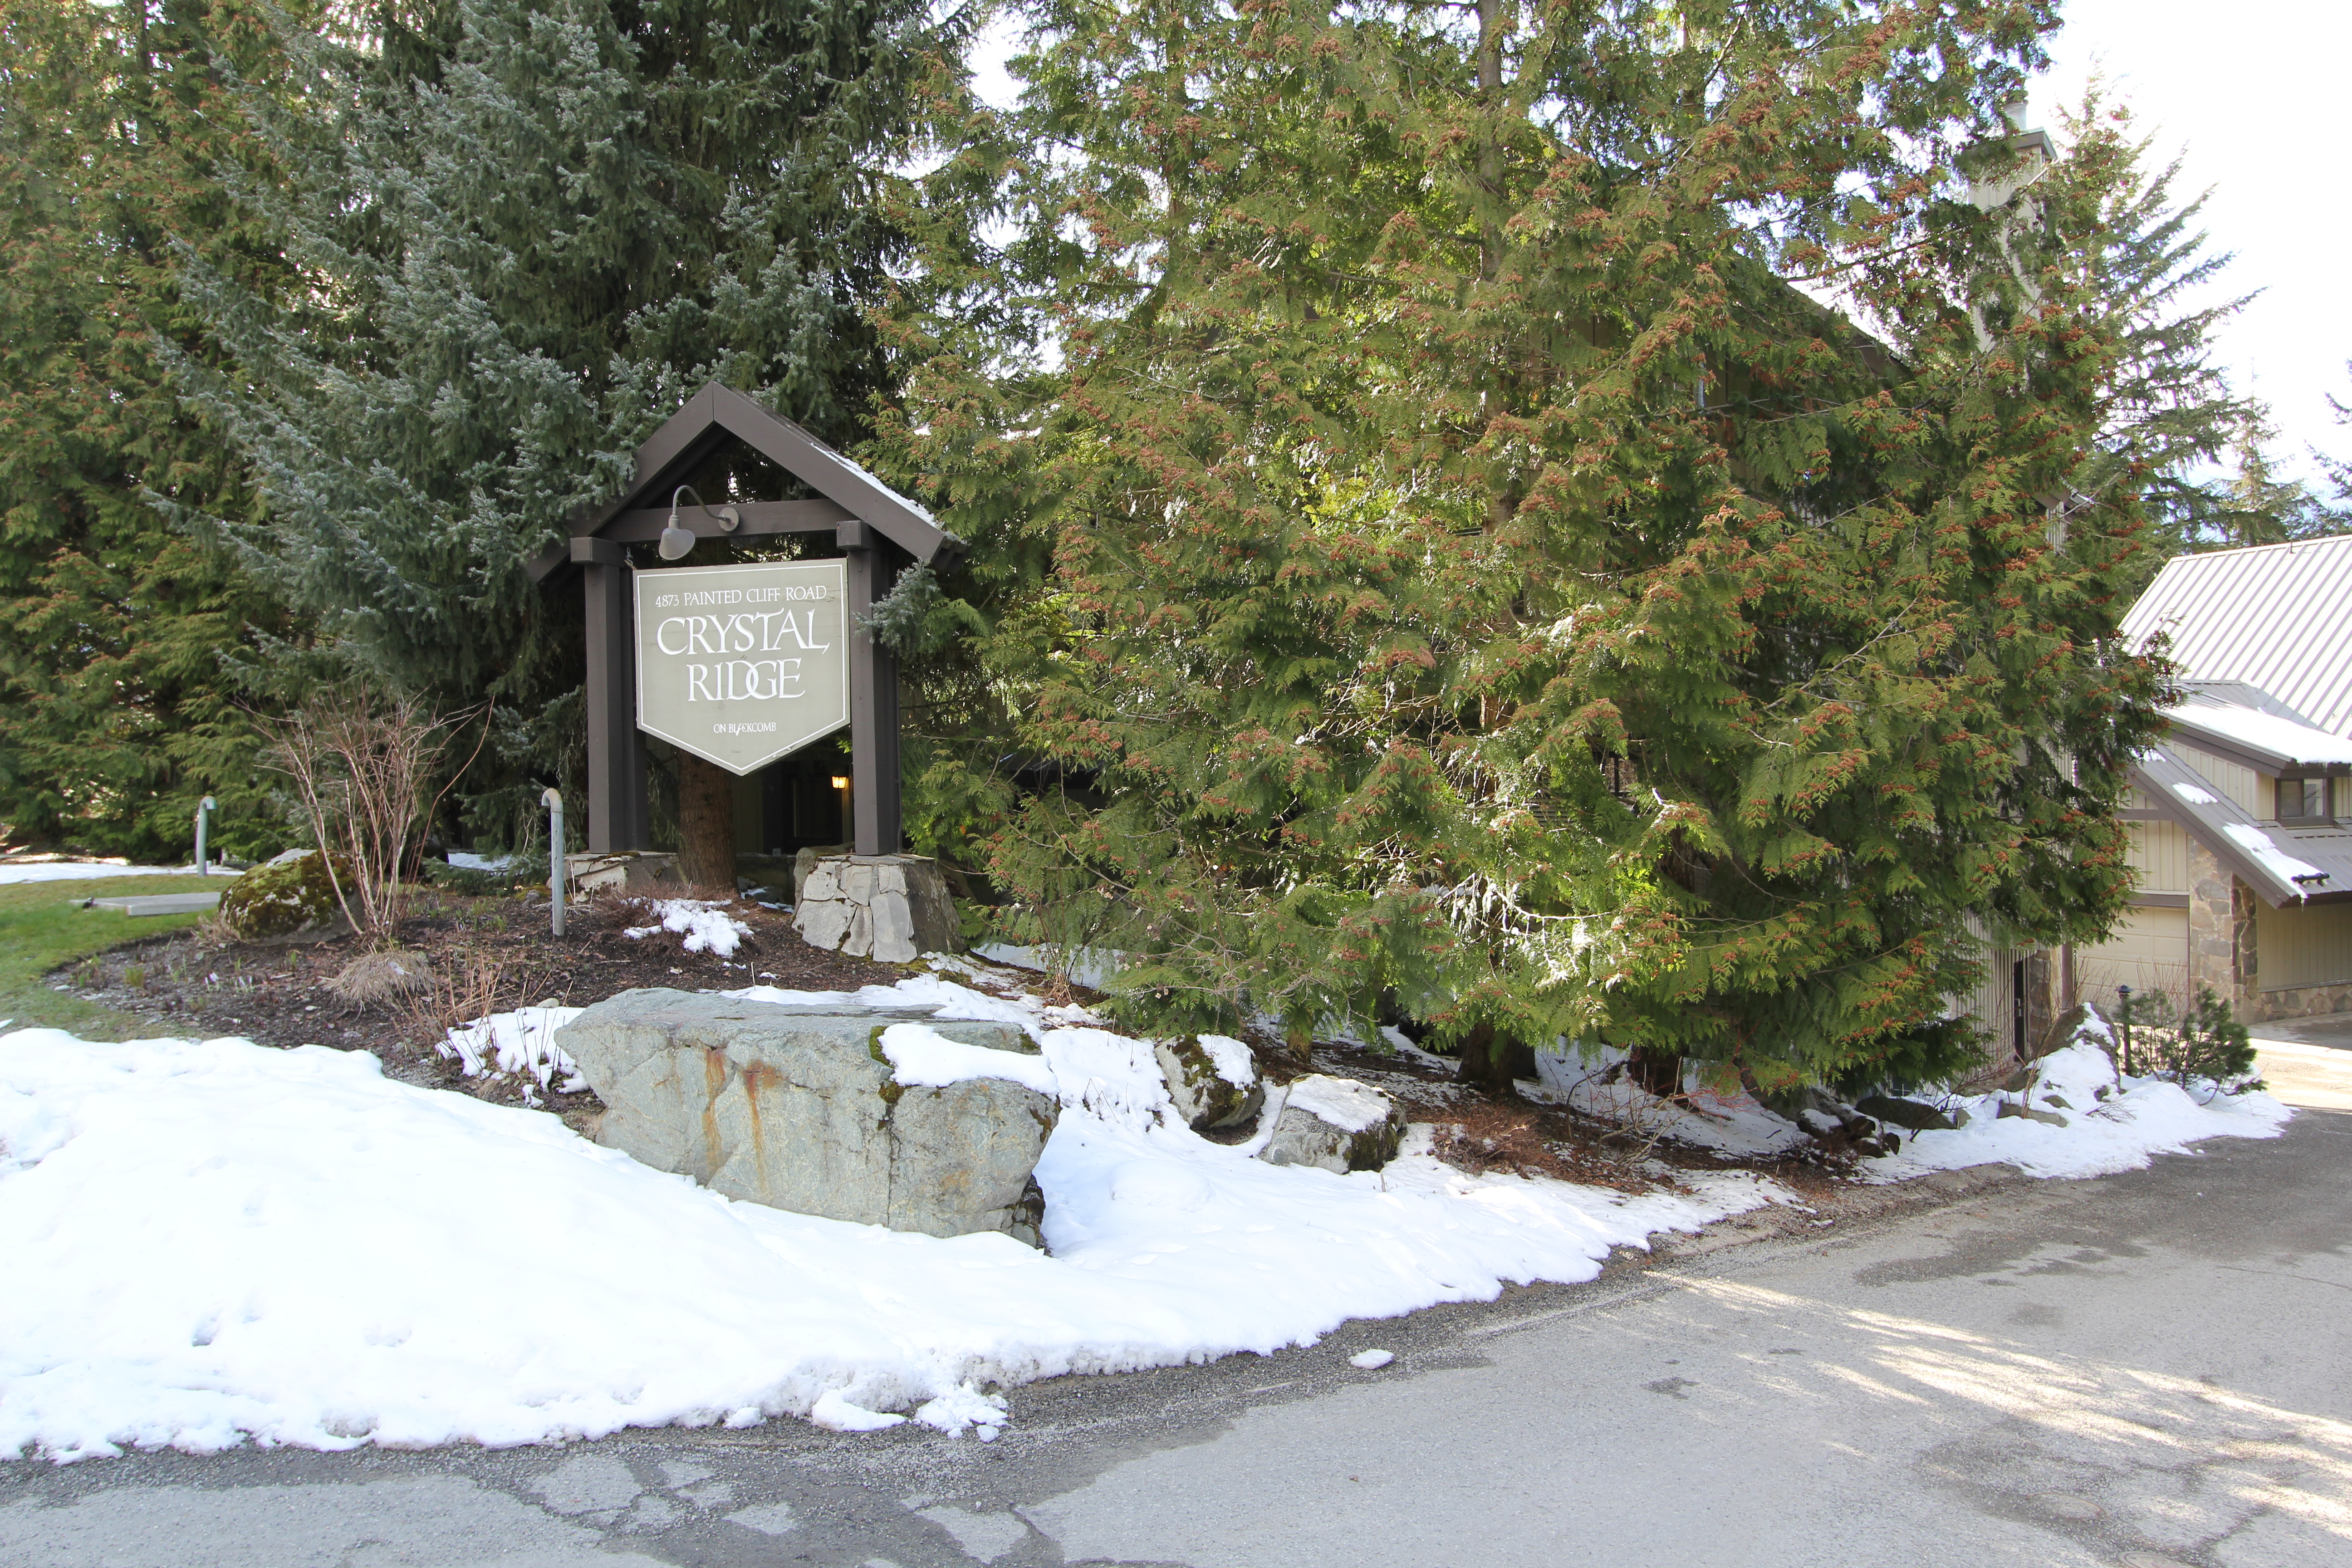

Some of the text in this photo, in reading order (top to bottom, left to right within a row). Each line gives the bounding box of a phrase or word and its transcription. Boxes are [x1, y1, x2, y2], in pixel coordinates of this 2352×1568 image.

[655, 585, 827, 607] 4873 PAINTED CLIFF ROAD
[657, 608, 830, 655] CRYSTAL
[686, 657, 805, 701] RIDGE
[713, 723, 726, 734] ON
